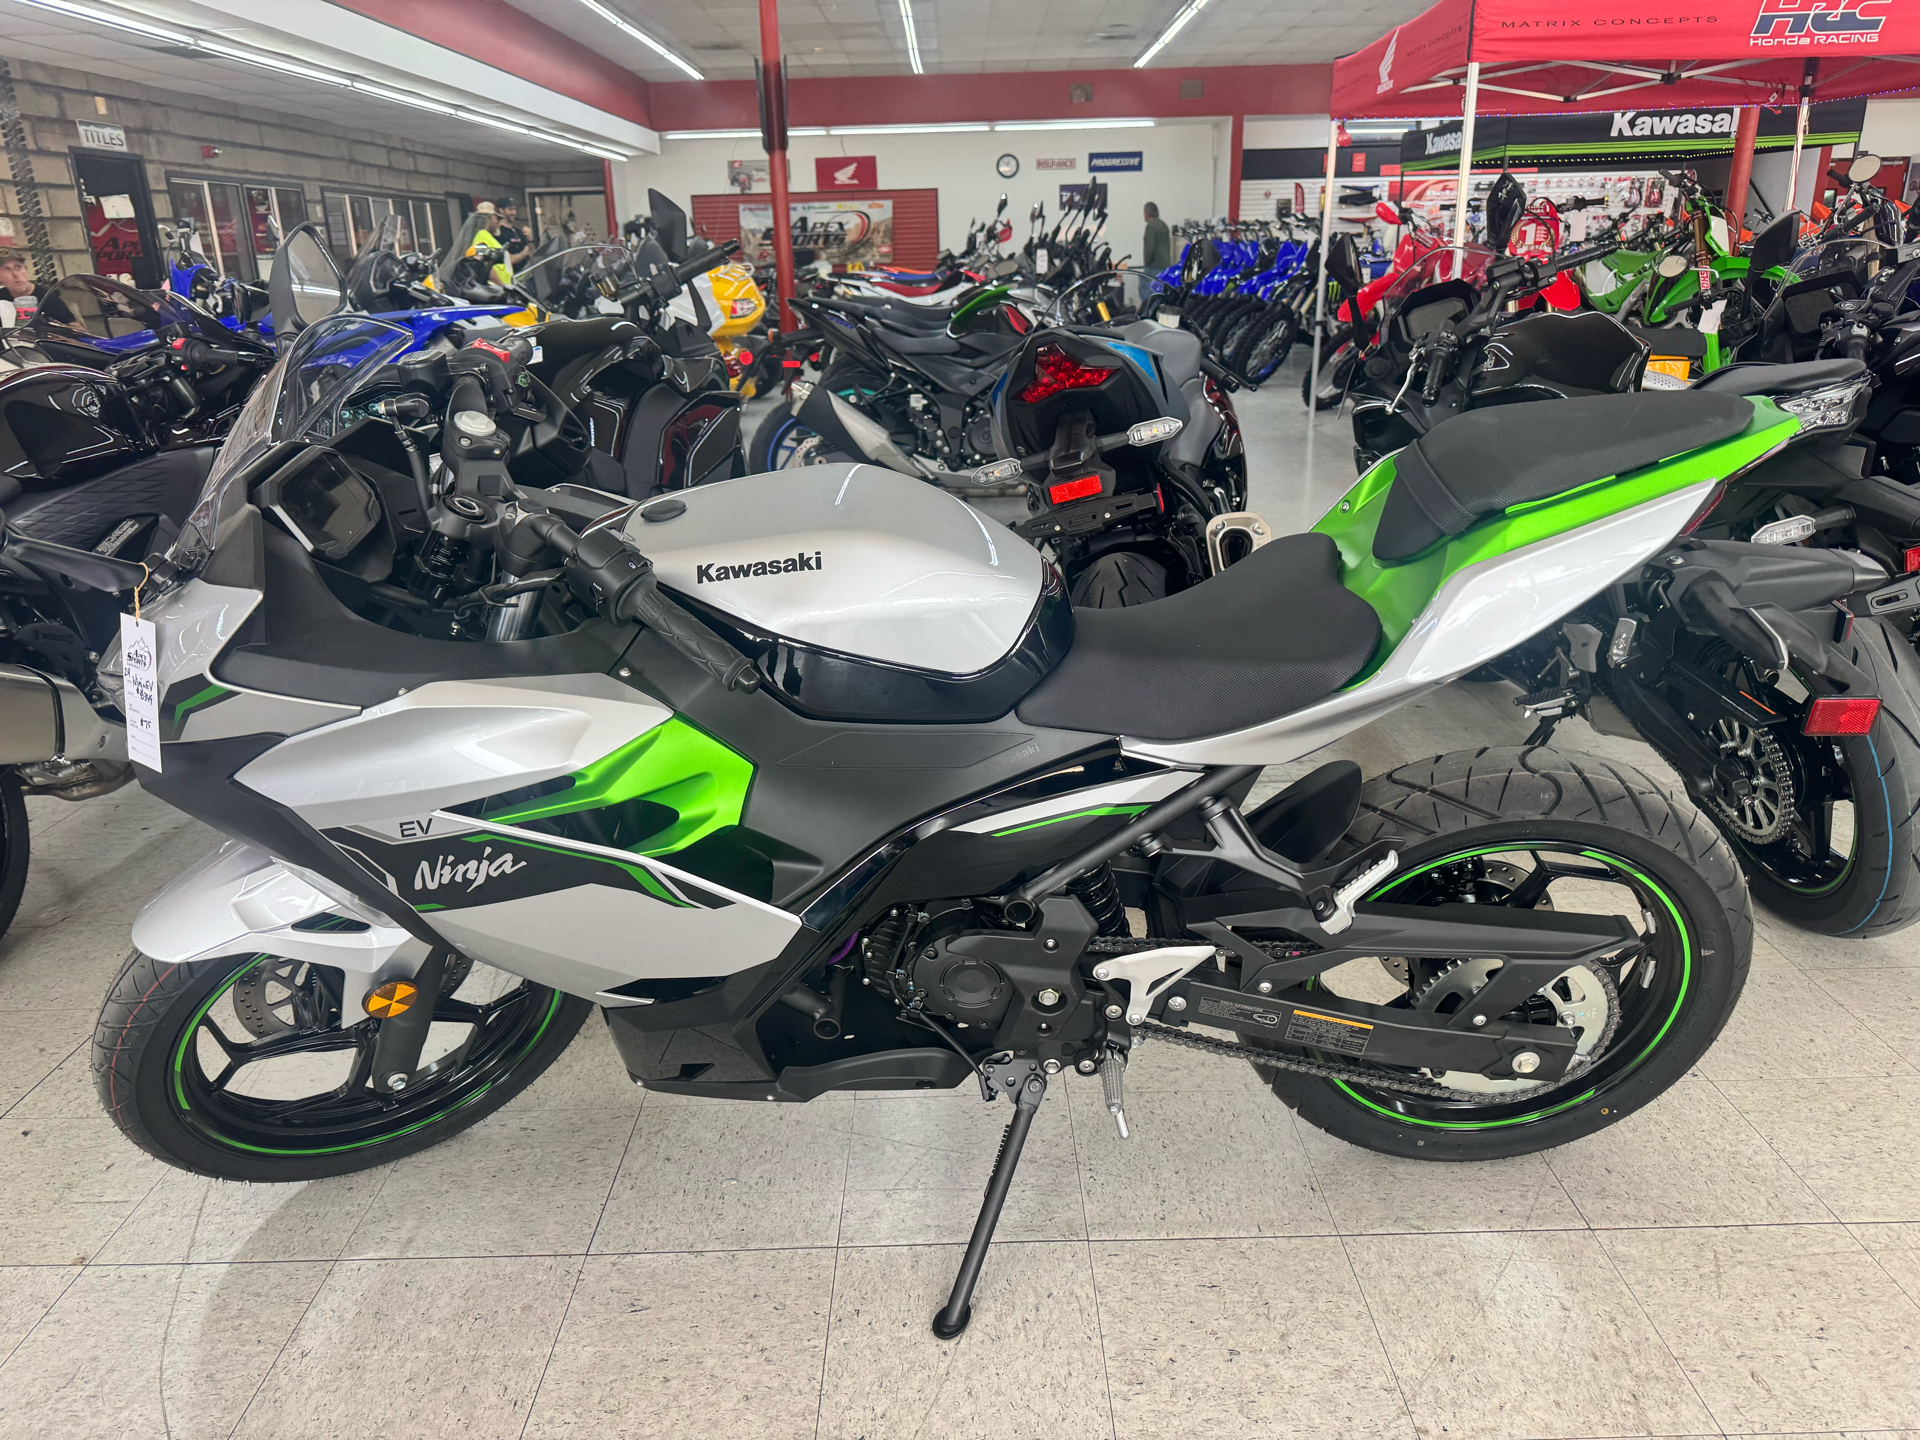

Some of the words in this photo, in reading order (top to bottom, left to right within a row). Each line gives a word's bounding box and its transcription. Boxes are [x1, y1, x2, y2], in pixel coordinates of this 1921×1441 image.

[1501, 19, 1581, 28] MATRIX
[1593, 16, 1718, 26] CONCEPTS
[1750, 35, 1811, 46] Honda
[1813, 33, 1879, 45] RACING
[83, 128, 124, 146] TITLES
[1425, 127, 1463, 155] Kawasa
[1090, 157, 1140, 167] PROGRESSIVE
[791, 216, 848, 234] APEX
[696, 551, 822, 585] Kawasaki
[399, 817, 433, 838] EV
[414, 846, 528, 893] Ninja
